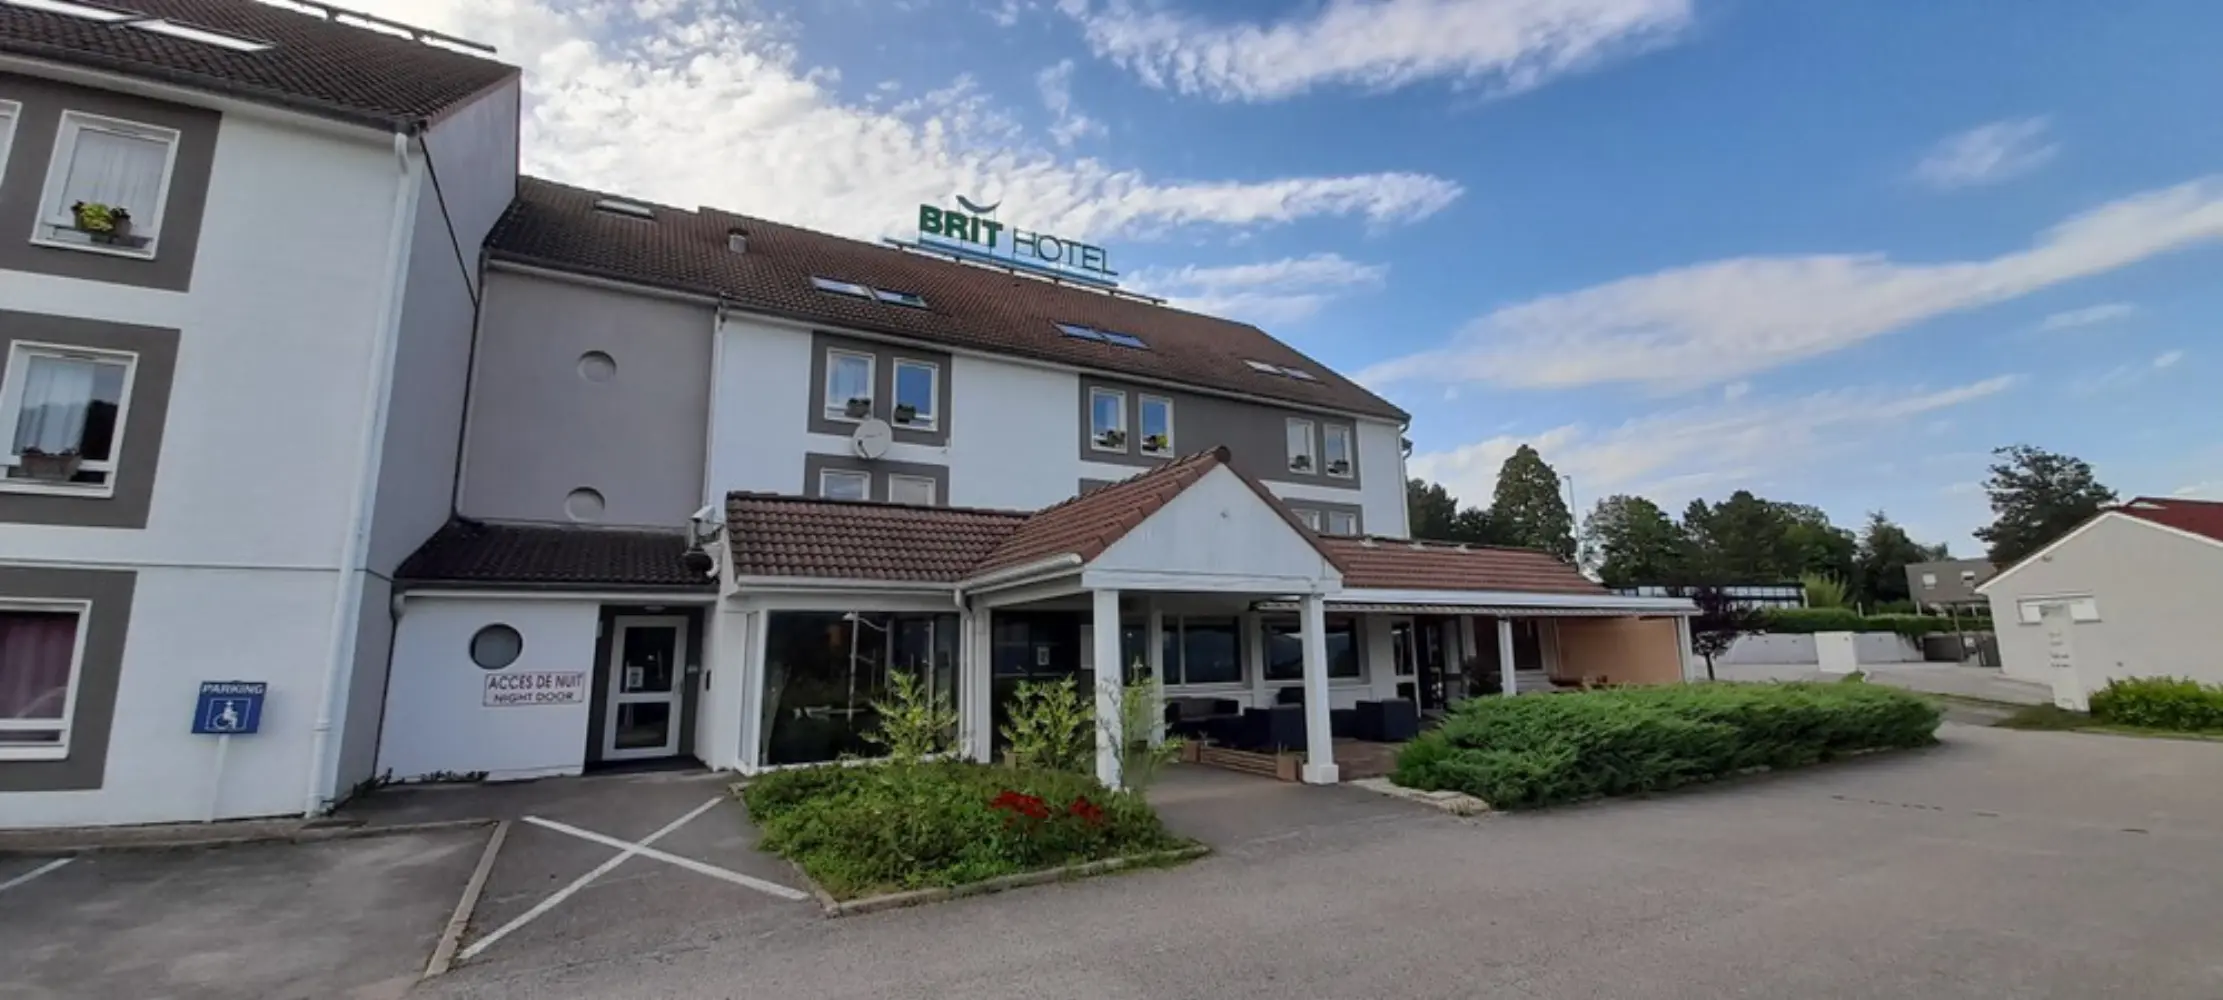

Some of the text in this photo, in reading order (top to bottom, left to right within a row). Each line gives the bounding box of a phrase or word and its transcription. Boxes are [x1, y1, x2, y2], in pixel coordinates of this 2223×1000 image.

[919, 203, 1118, 277] BRIT HOTEL
[536, 674, 552, 689] DE
[555, 674, 581, 688] NUIT
[202, 683, 264, 694] PARKING
[493, 692, 573, 703] NIGHT DOOR
